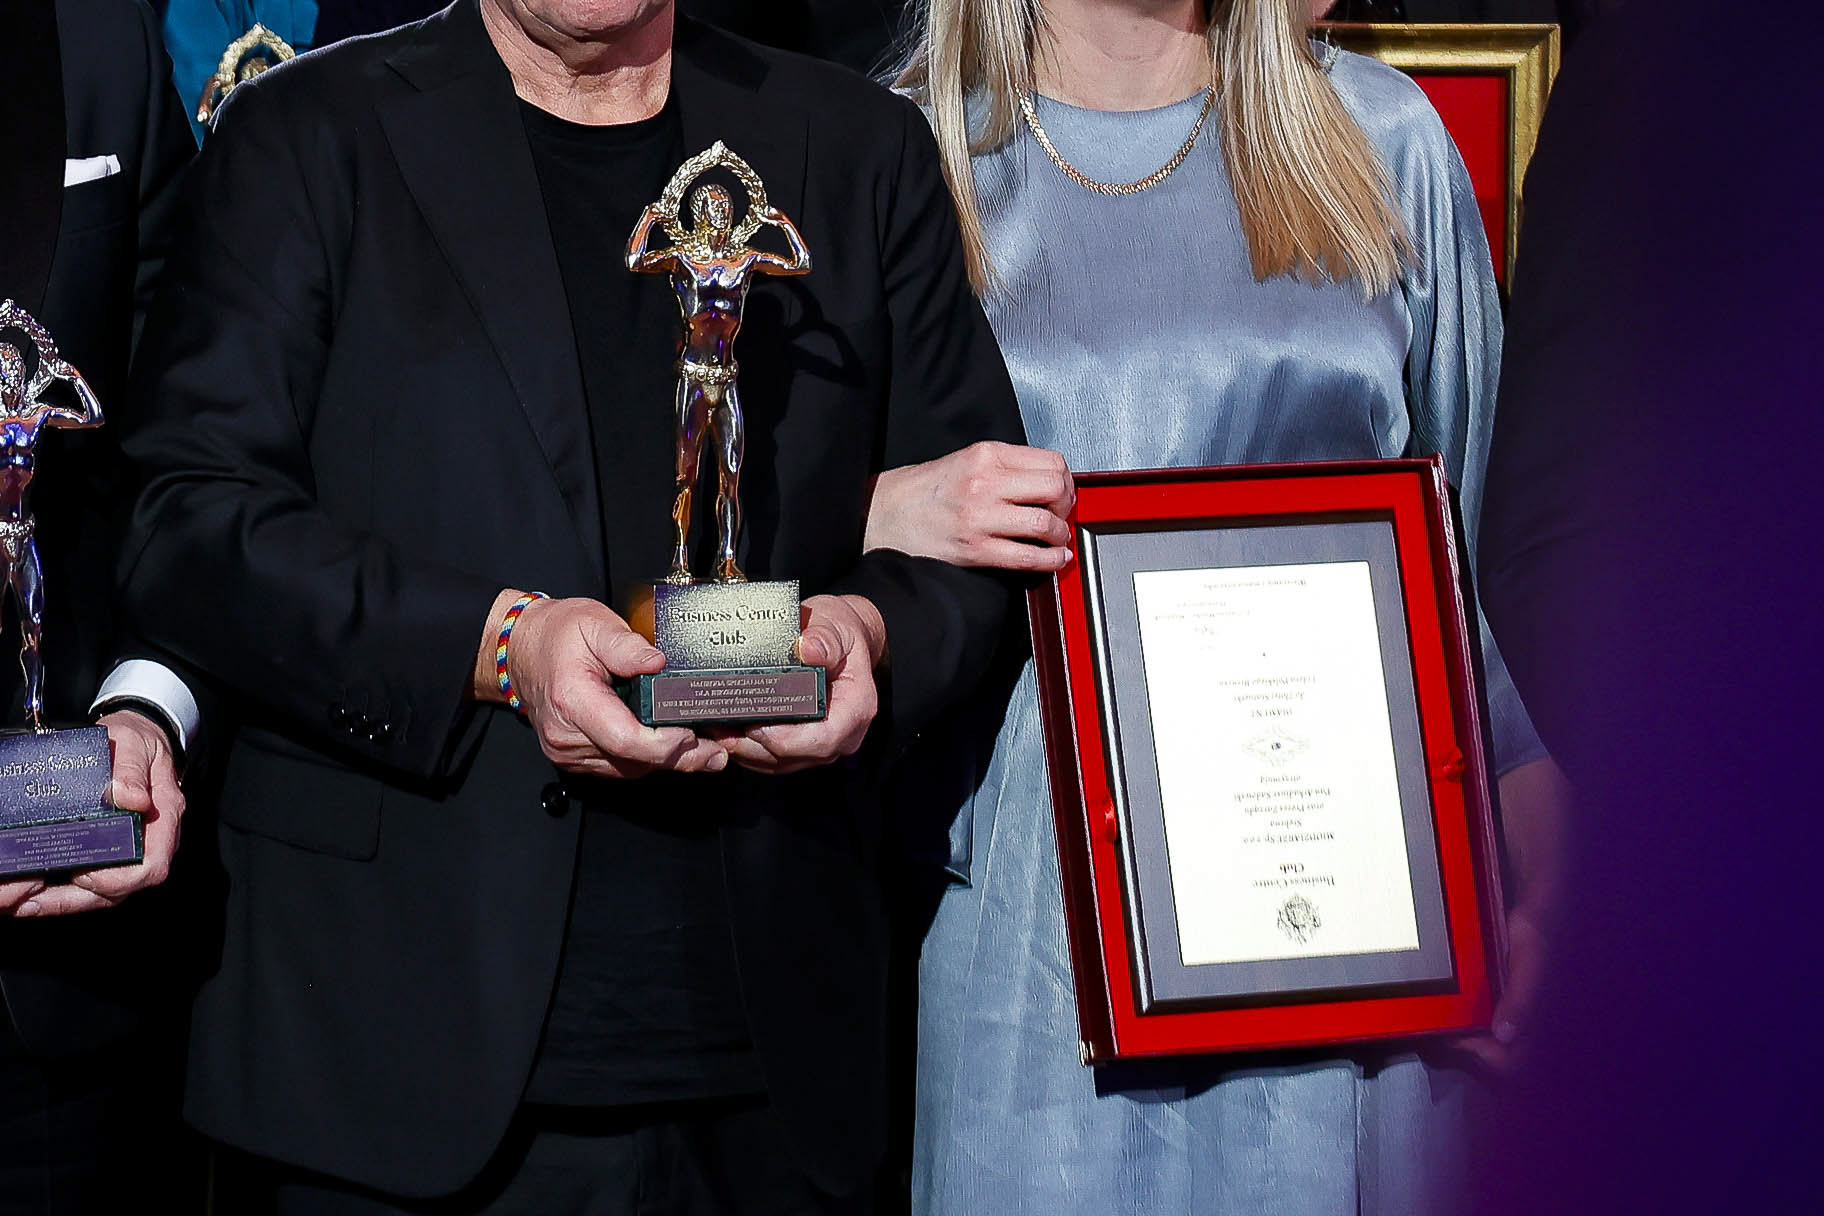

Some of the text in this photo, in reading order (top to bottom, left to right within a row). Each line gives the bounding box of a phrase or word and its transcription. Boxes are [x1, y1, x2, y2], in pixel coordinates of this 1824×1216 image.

[670, 604, 788, 623] Business Centre
[709, 630, 747, 646] Club
[24, 778, 62, 798] Club
[1280, 862, 1304, 874] Club
